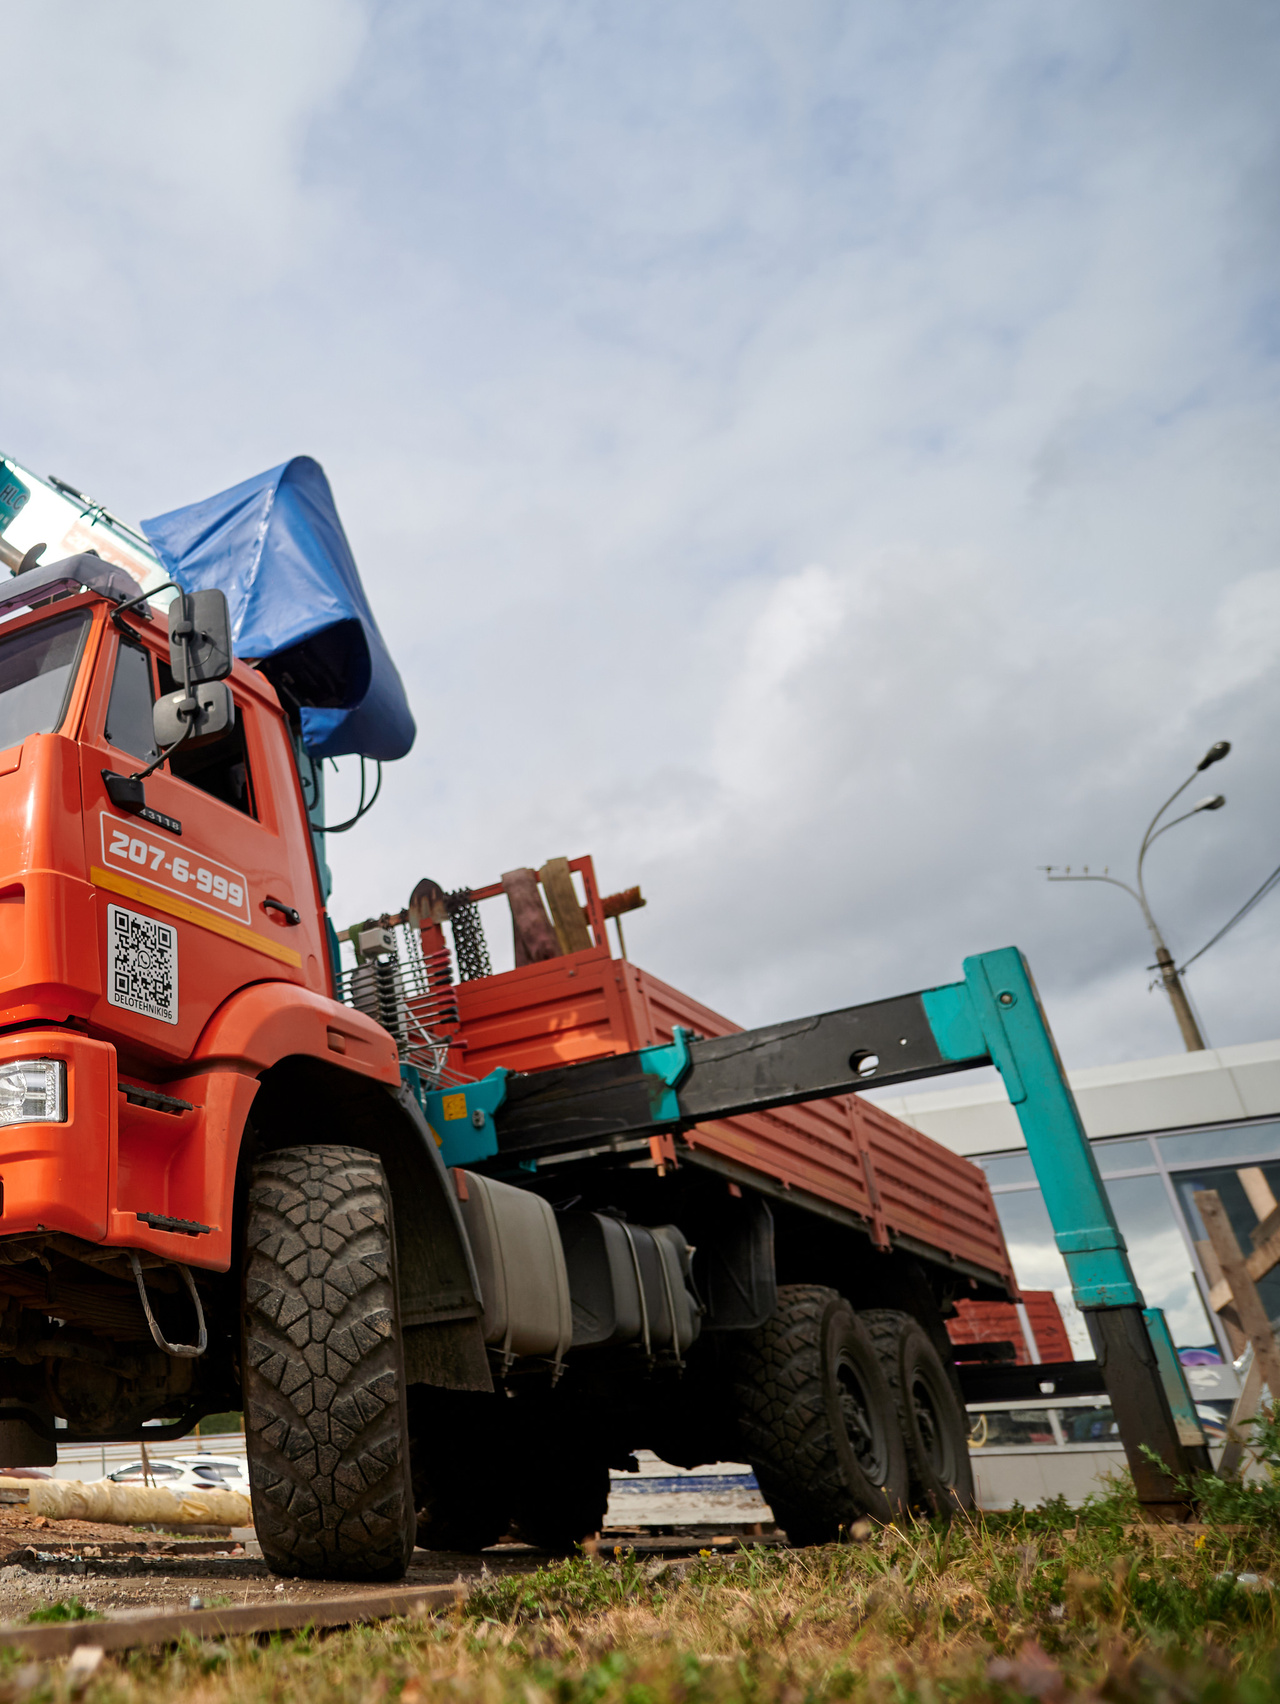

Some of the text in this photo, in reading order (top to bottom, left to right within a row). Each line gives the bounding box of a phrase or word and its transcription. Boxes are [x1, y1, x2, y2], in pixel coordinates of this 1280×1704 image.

[140, 808, 179, 830] 43118
[109, 830, 243, 908] 207-6-999
[114, 993, 173, 1020] DELOTEHNIKI96
